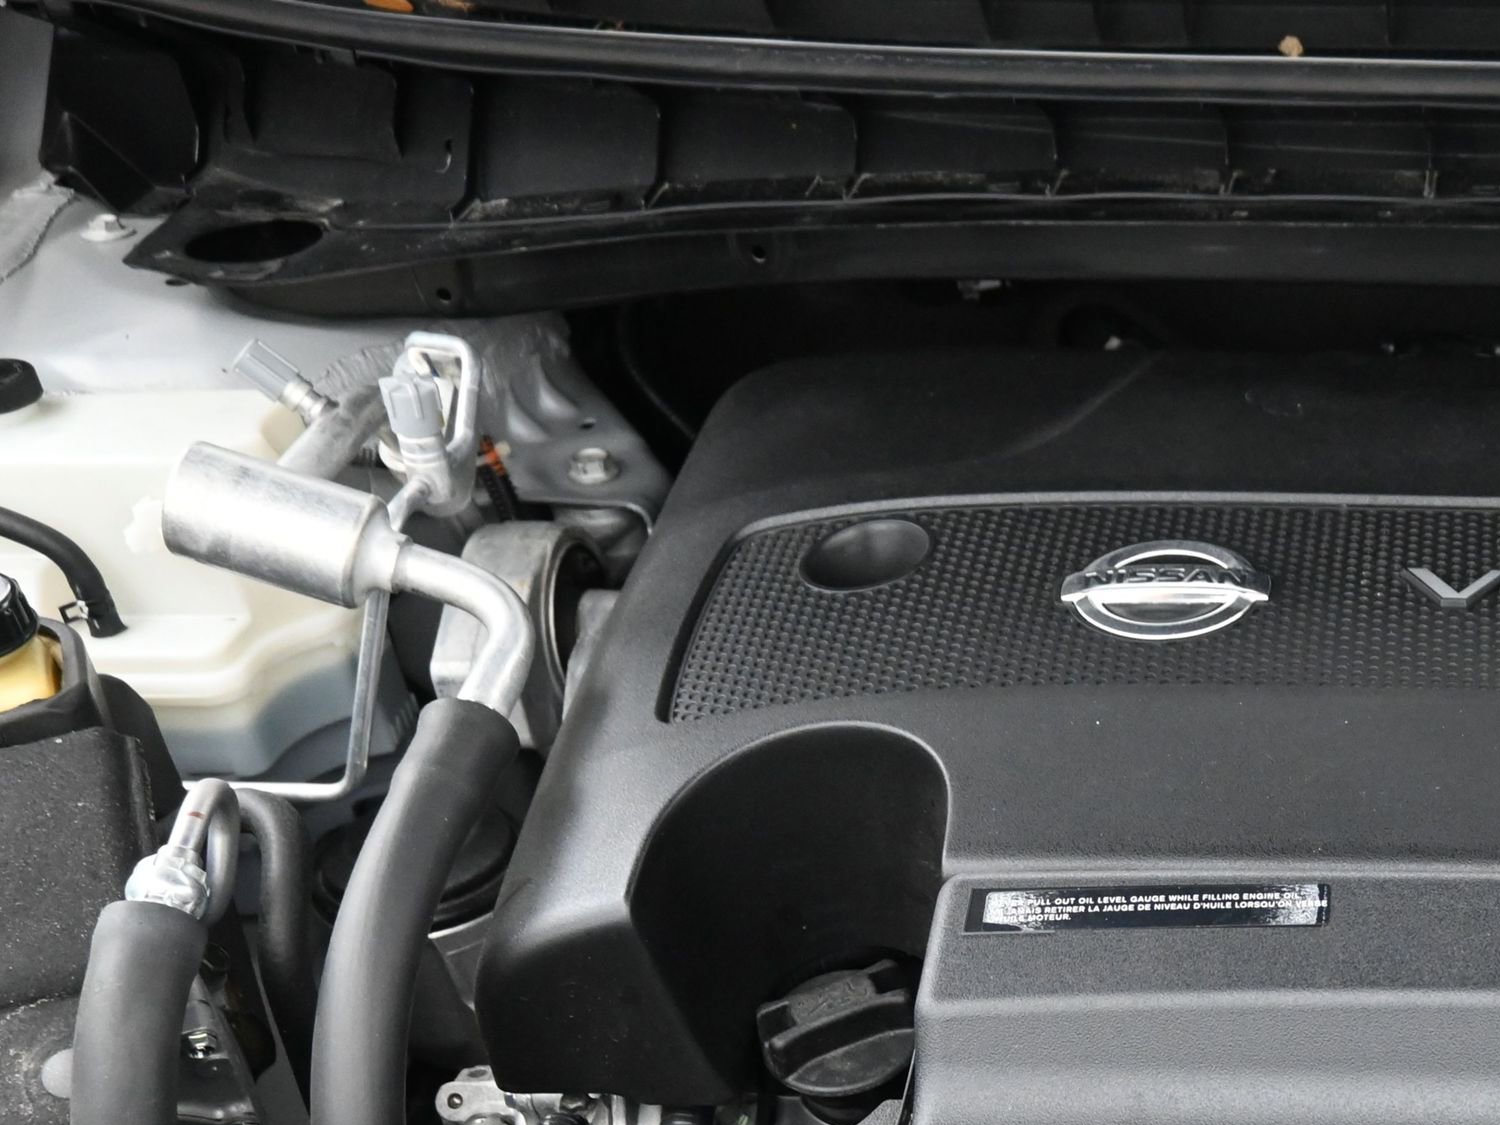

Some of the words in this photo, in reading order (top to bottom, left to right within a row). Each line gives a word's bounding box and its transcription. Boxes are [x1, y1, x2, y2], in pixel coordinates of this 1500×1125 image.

[1085, 567, 1249, 584] NISSAN
[1027, 898, 1051, 906] PULL
[1055, 897, 1075, 905] OUT
[1079, 897, 1094, 905] OIL
[1098, 896, 1127, 904] LEVEL
[1130, 895, 1166, 903] GAUGE
[1169, 894, 1199, 902] WHILE
[1202, 893, 1240, 901] FILLING
[1243, 892, 1281, 900] ENGINE
[1044, 905, 1085, 914] RETIRER
[1102, 904, 1135, 912] JAUGE
[1138, 903, 1151, 911] DE
[1154, 902, 1190, 911] NIVEAU
[1193, 901, 1232, 909] D'HUILE
[1235, 900, 1292, 909] LORSQU'ON
[1027, 913, 1072, 922] MOTEUR.
